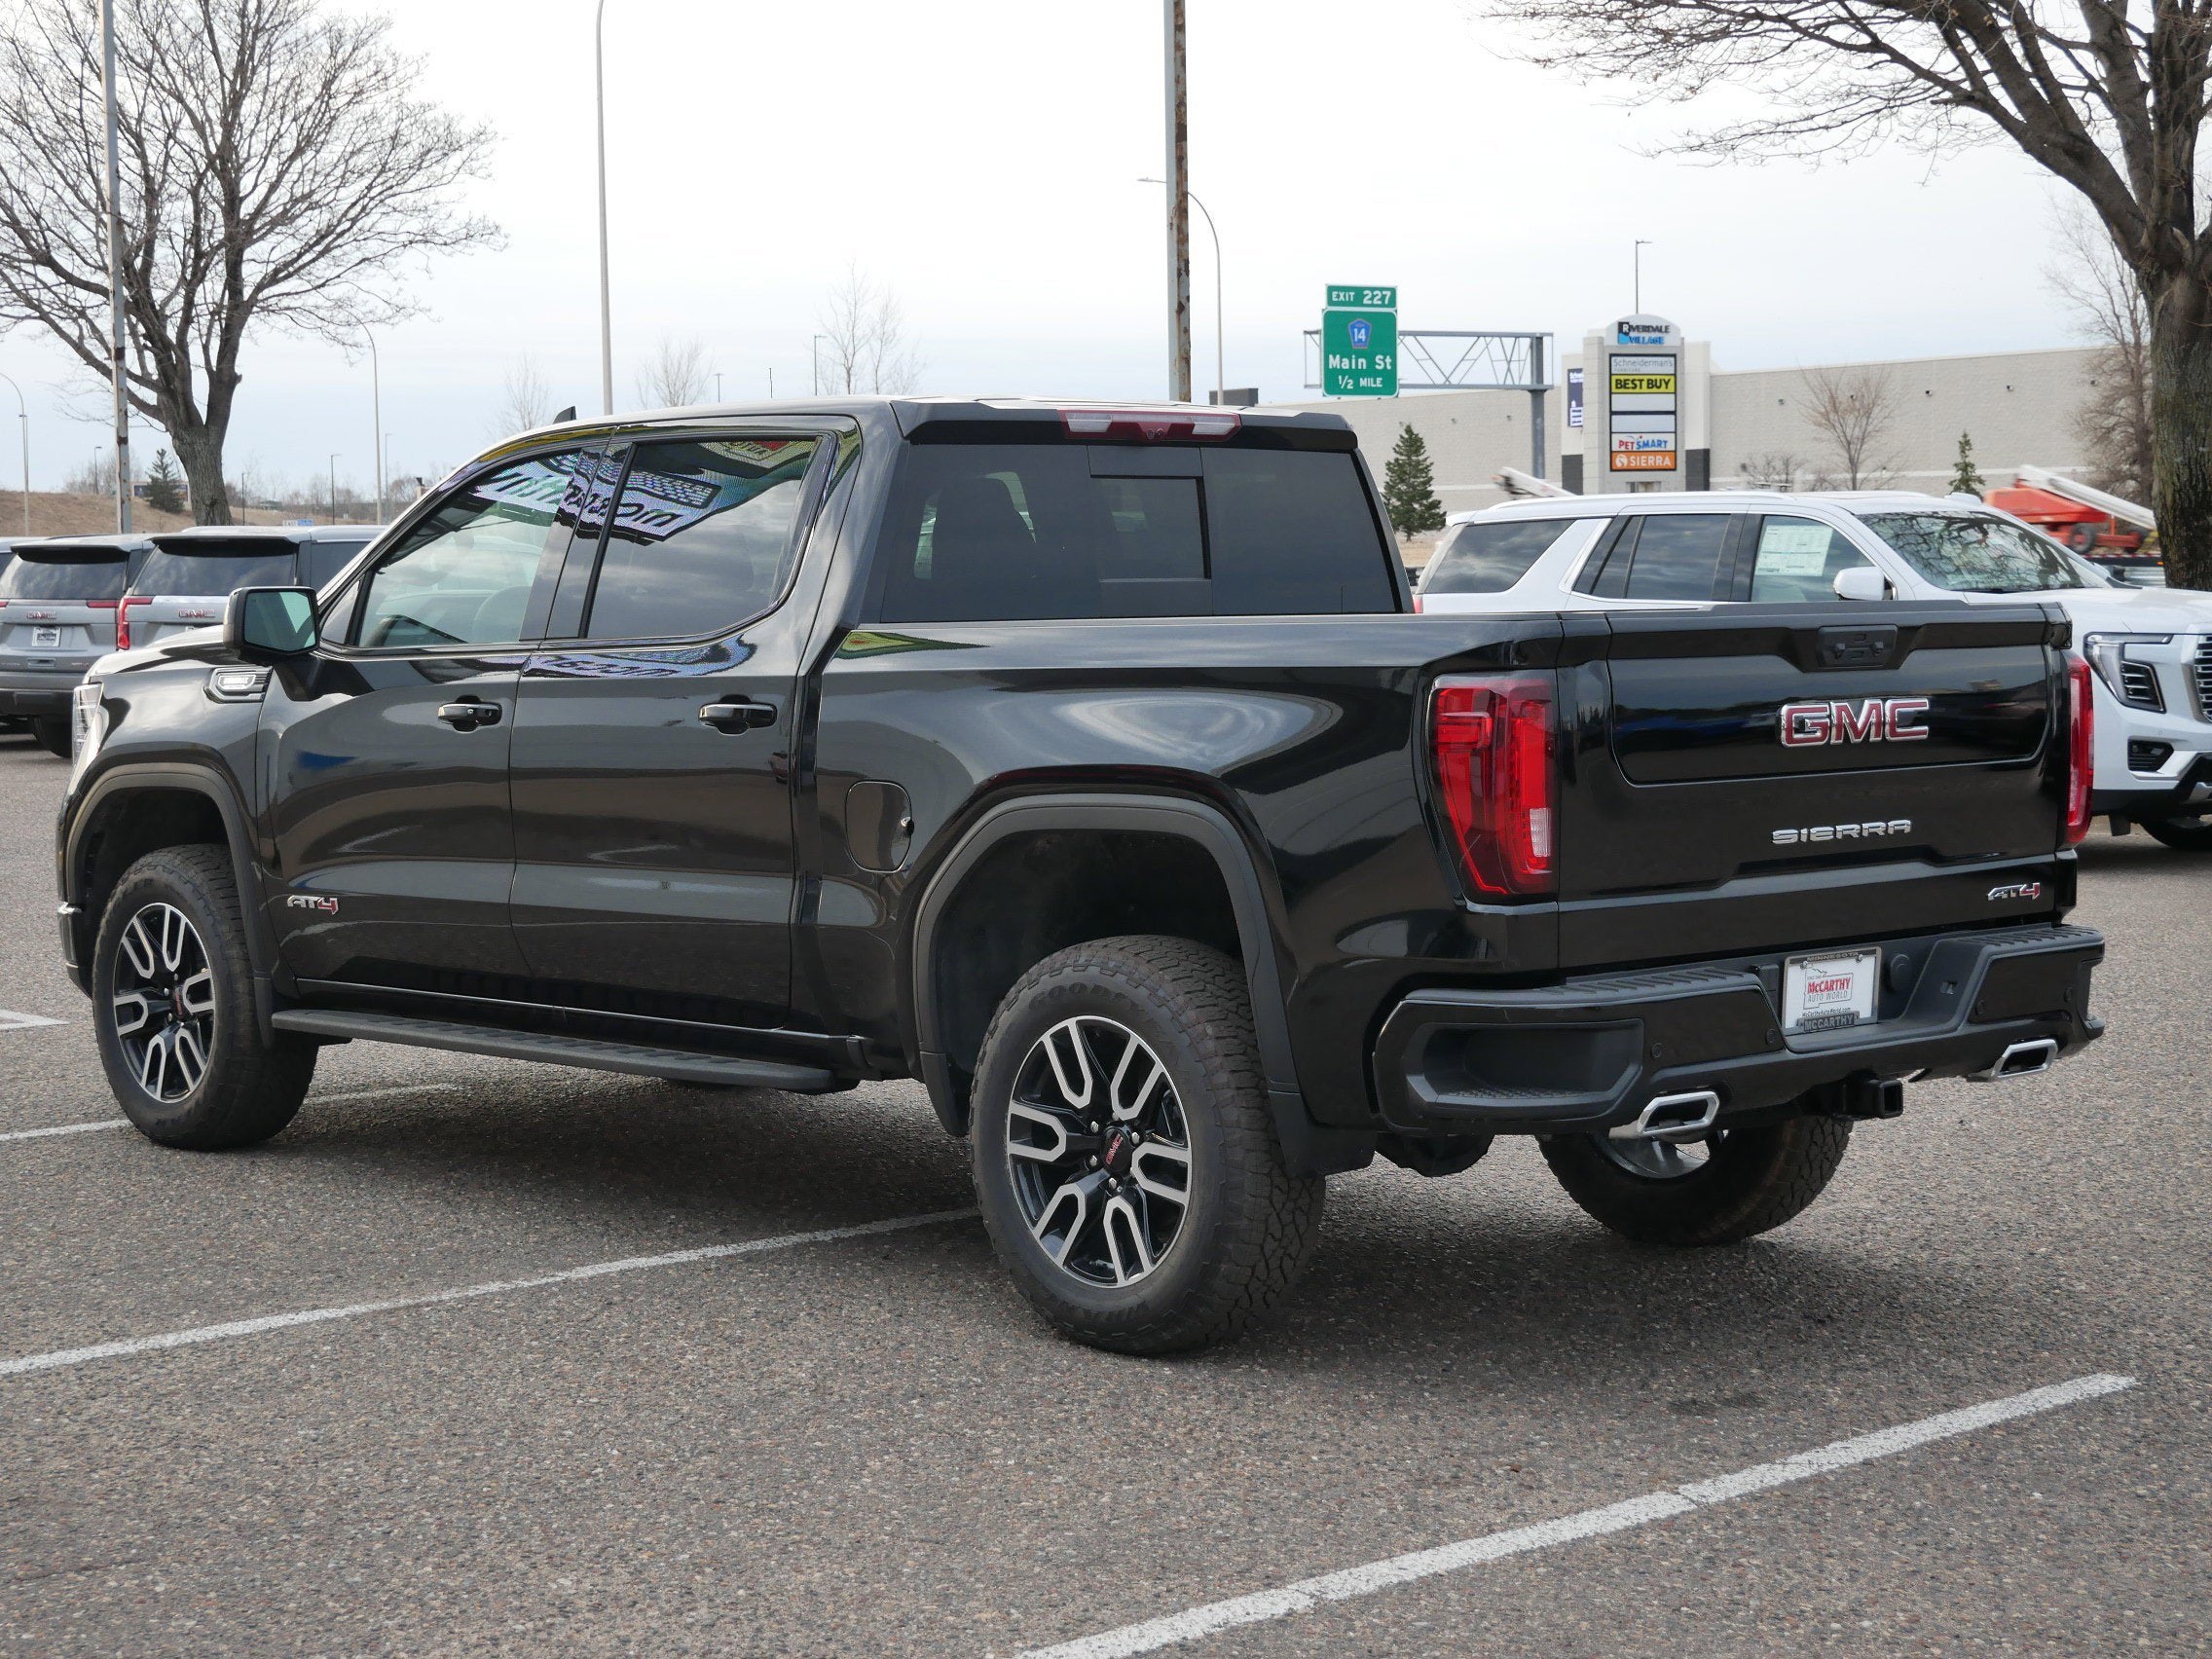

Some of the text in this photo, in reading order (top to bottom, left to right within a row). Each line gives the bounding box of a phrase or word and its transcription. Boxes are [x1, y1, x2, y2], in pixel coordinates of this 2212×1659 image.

[1331, 290, 1391, 305] EXIT 227
[1353, 327, 1367, 343] 14
[1629, 336, 1665, 345] VILLAGE
[1328, 354, 1392, 370] Main St
[1359, 377, 1383, 388] MILE
[1614, 378, 1672, 390] BEST BUY
[1630, 455, 1672, 467] SIERRA
[178, 608, 216, 619] GMC
[1780, 697, 1931, 749] GMC
[1771, 819, 1912, 845] SIERRA
[1986, 882, 2041, 902] AT4
[286, 895, 340, 915] AT4
[1807, 977, 1851, 994] McCARTHY
[1807, 990, 1848, 1004] AUTO WORLD
[1804, 1014, 1854, 1031] MCCARTHY
[1105, 1133, 1124, 1165] GMC
